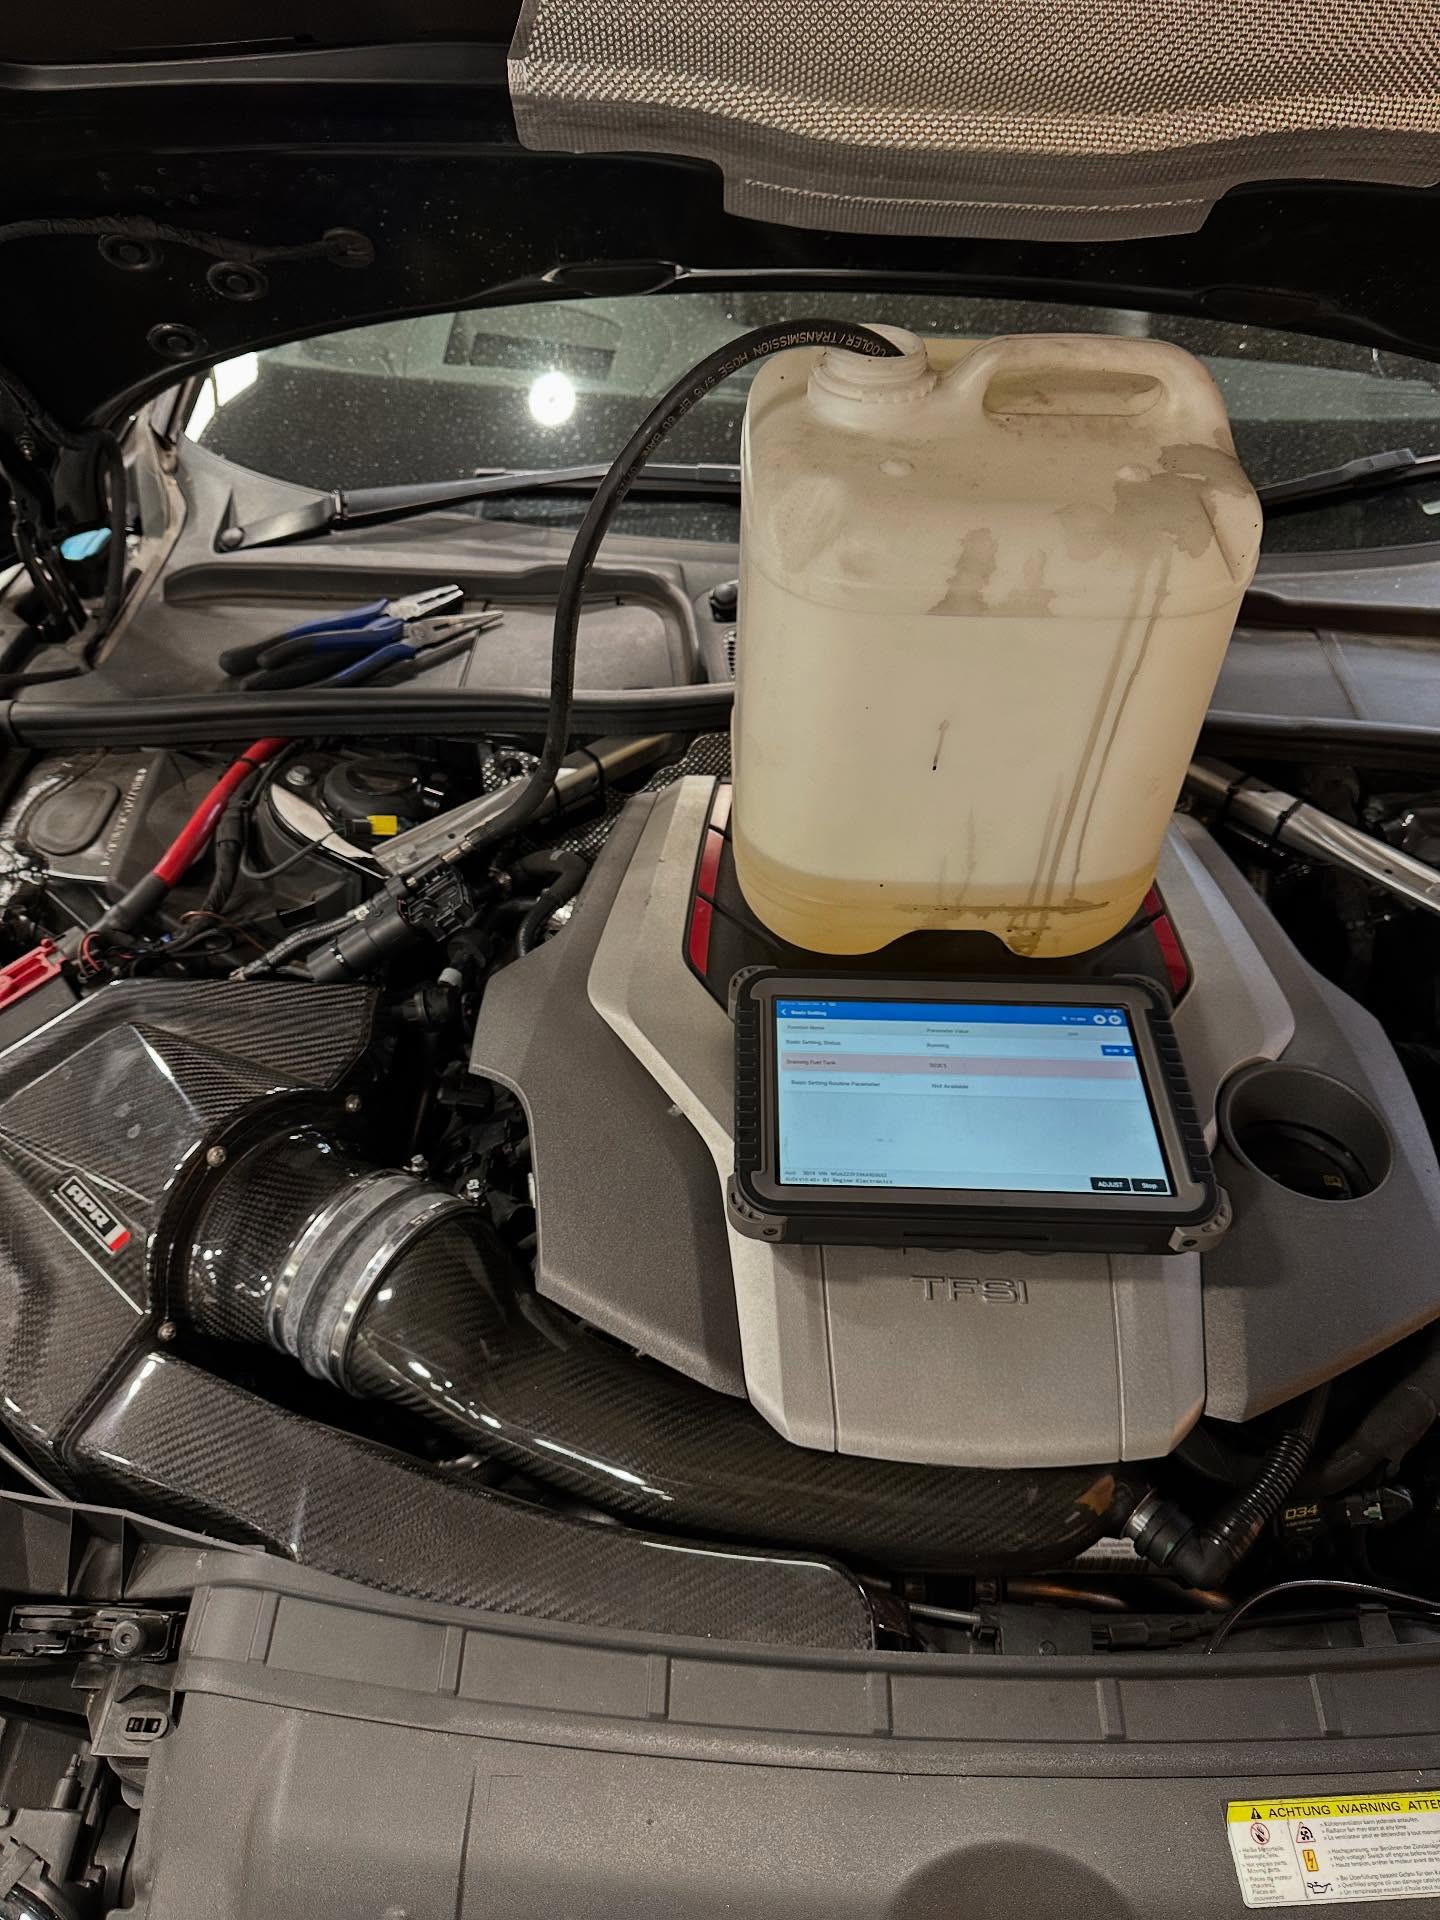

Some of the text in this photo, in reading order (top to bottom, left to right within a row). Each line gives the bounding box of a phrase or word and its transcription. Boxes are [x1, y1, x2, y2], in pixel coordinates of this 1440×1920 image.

[752, 330, 838, 358] TRANSMISSION
[846, 333, 887, 358] COOLER
[718, 355, 749, 376] HOSE
[1141, 1182, 1158, 1190] Stop
[65, 1184, 111, 1228] APR
[910, 1274, 1029, 1305] TFSI
[1268, 1799, 1440, 1819] ACHTUNG WARNING ATTE
